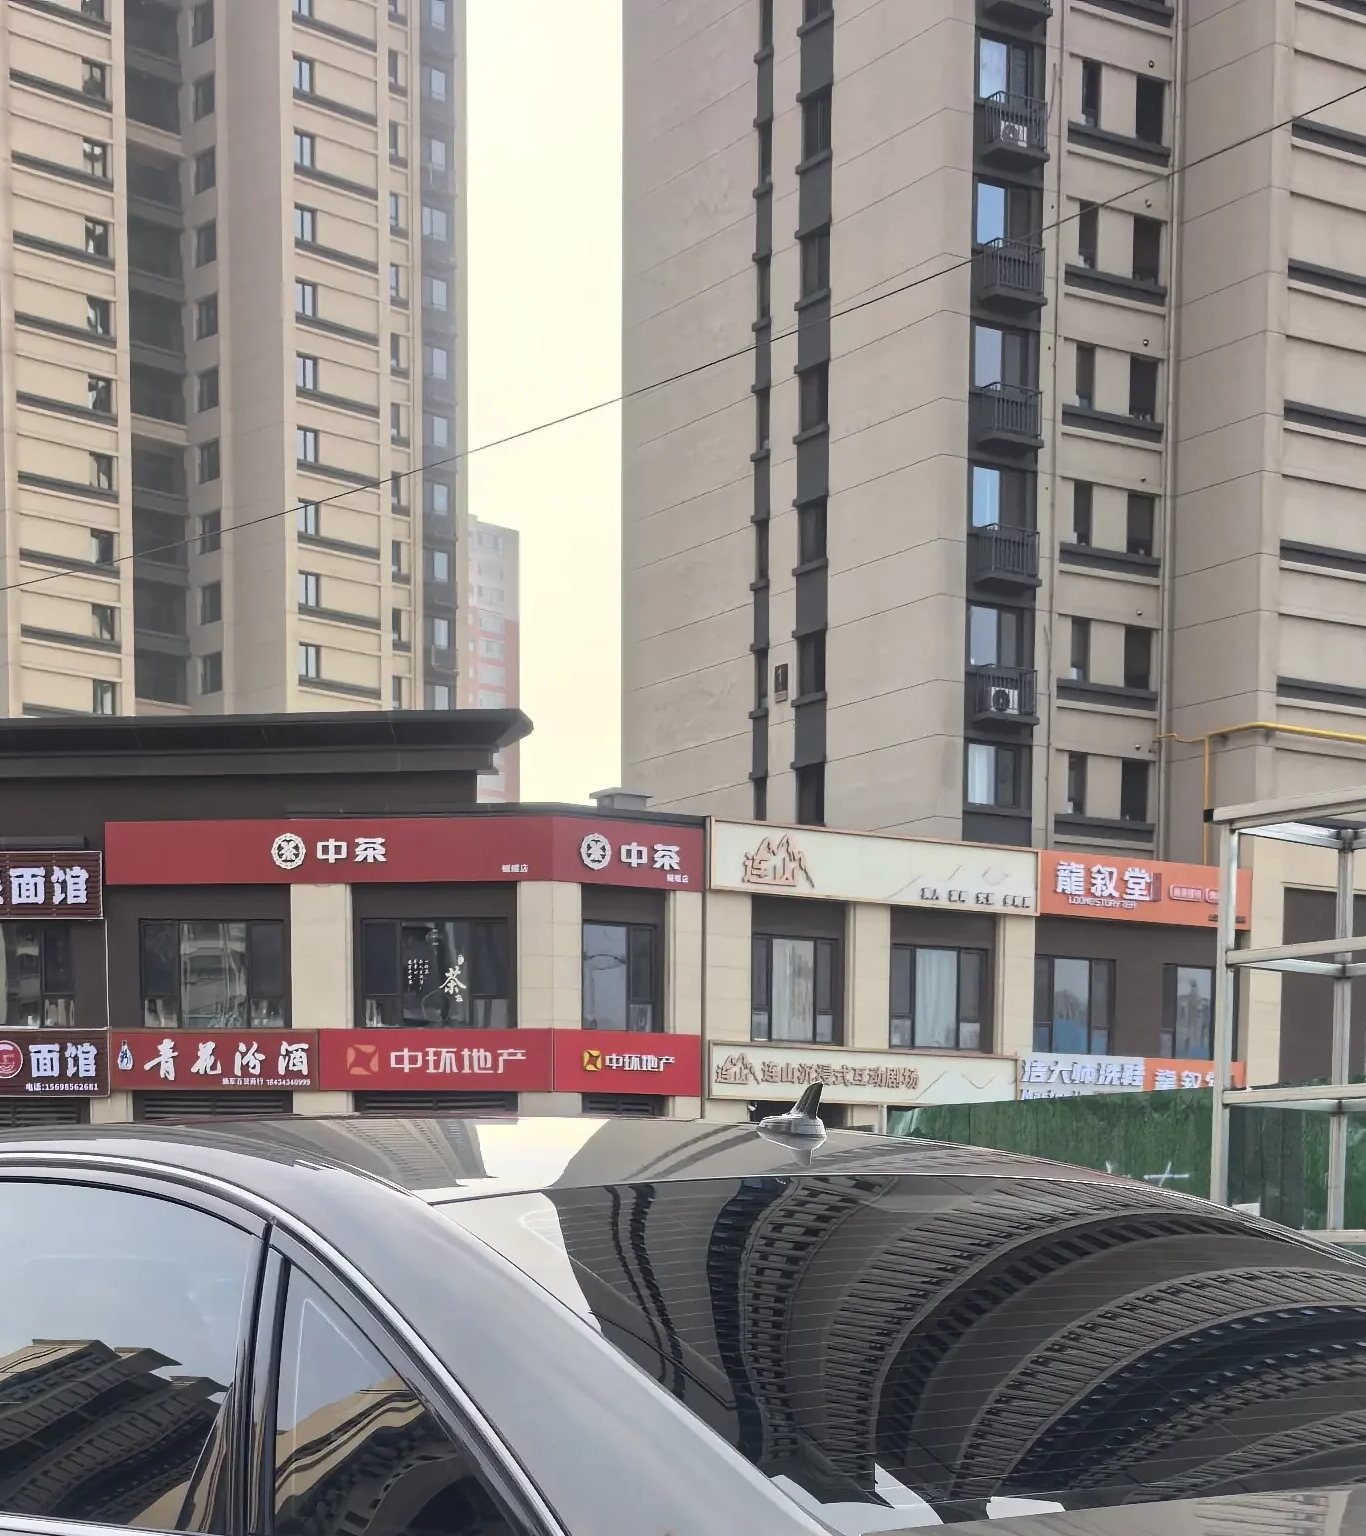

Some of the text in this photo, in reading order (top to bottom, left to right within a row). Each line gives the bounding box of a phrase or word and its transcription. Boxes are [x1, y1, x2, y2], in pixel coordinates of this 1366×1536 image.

[317, 837, 387, 863] 中茶
[620, 842, 680, 870] 中茶
[144, 1038, 309, 1081] 青花汾酒
[390, 1048, 527, 1075] 中环地产
[605, 1053, 675, 1073] 中环地产
